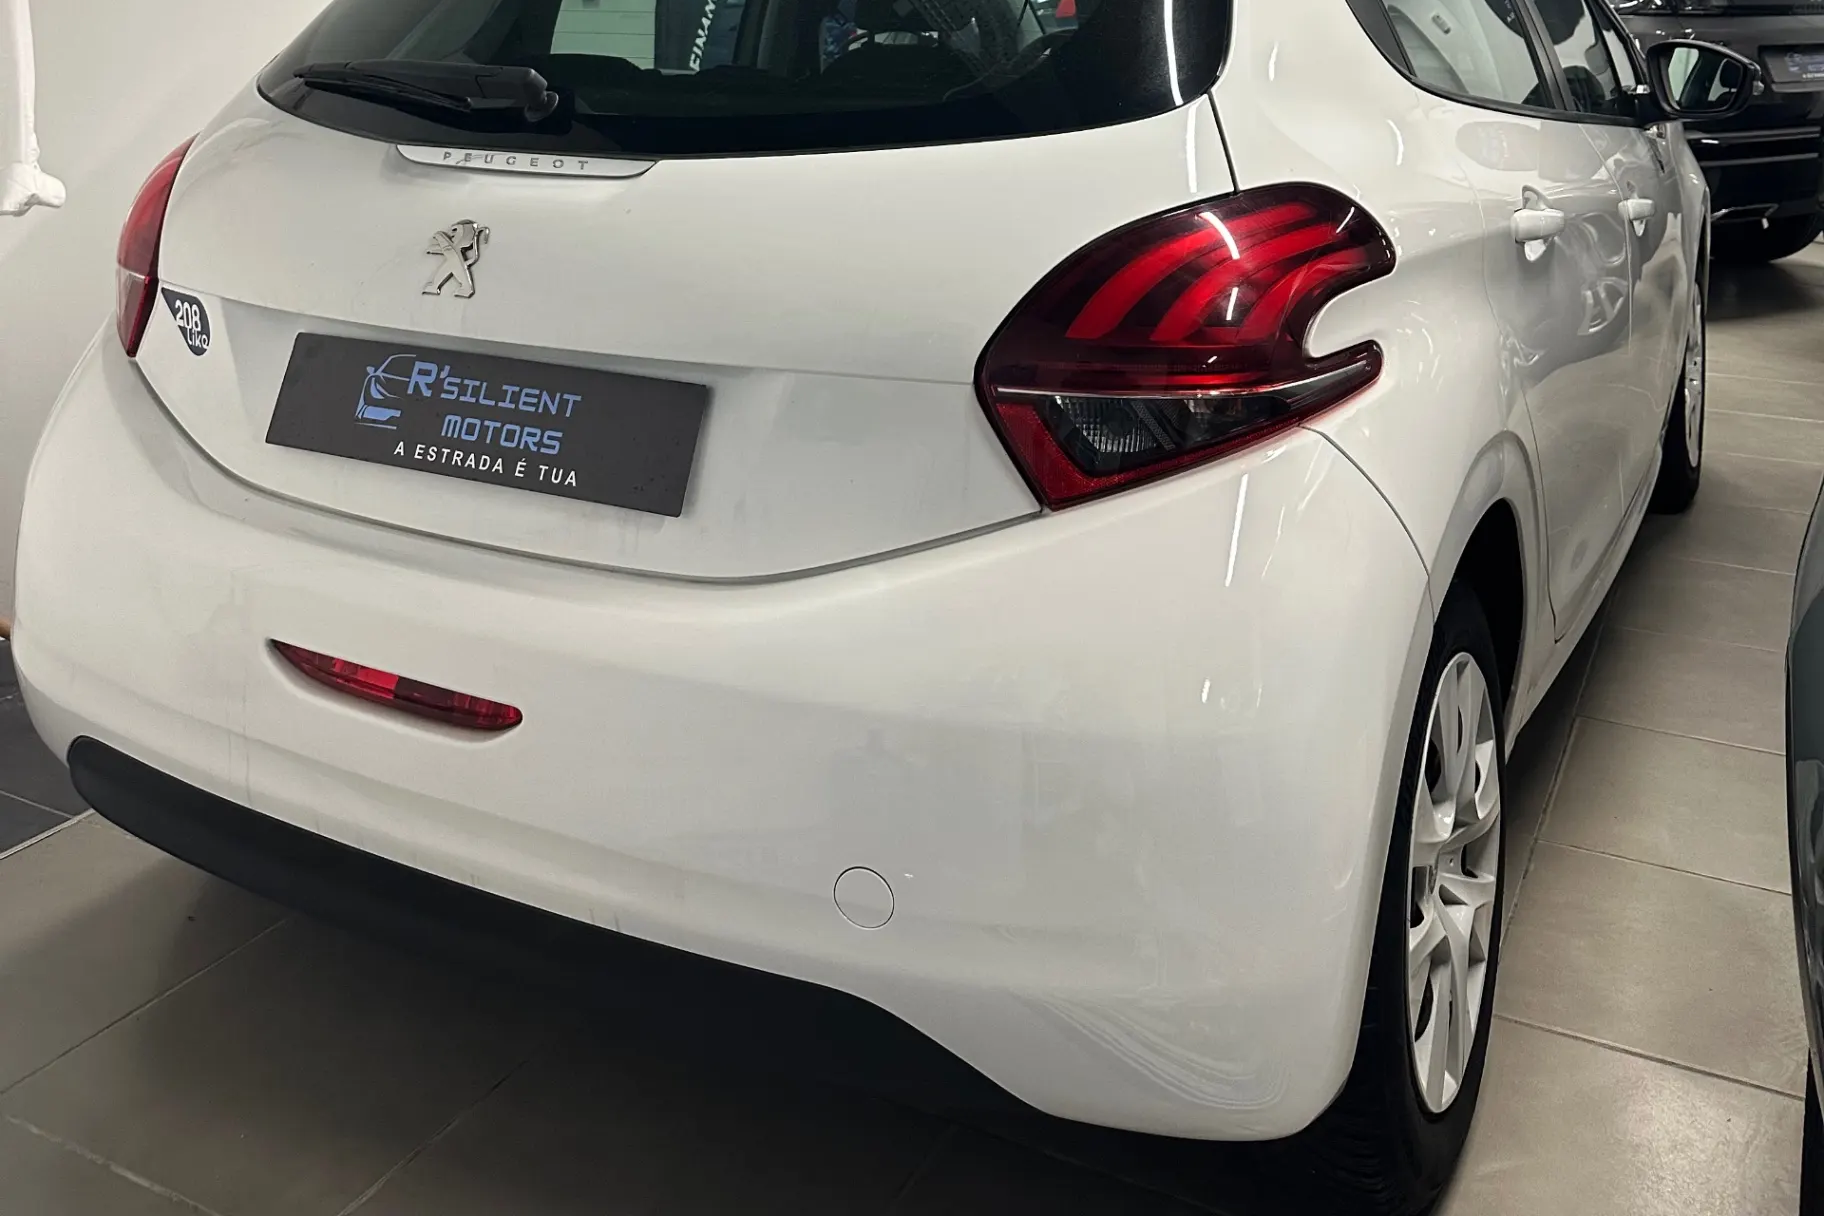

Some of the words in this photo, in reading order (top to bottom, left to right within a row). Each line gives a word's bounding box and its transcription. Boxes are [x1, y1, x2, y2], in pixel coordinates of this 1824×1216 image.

[443, 150, 589, 172] PEUGEOT
[174, 298, 202, 332] 208
[406, 360, 582, 418] R'SILIENT
[440, 414, 564, 456] MOTORS
[393, 441, 406, 457] A
[413, 444, 504, 475] ESTRADA
[514, 458, 526, 479] É
[539, 465, 578, 488] TUA
